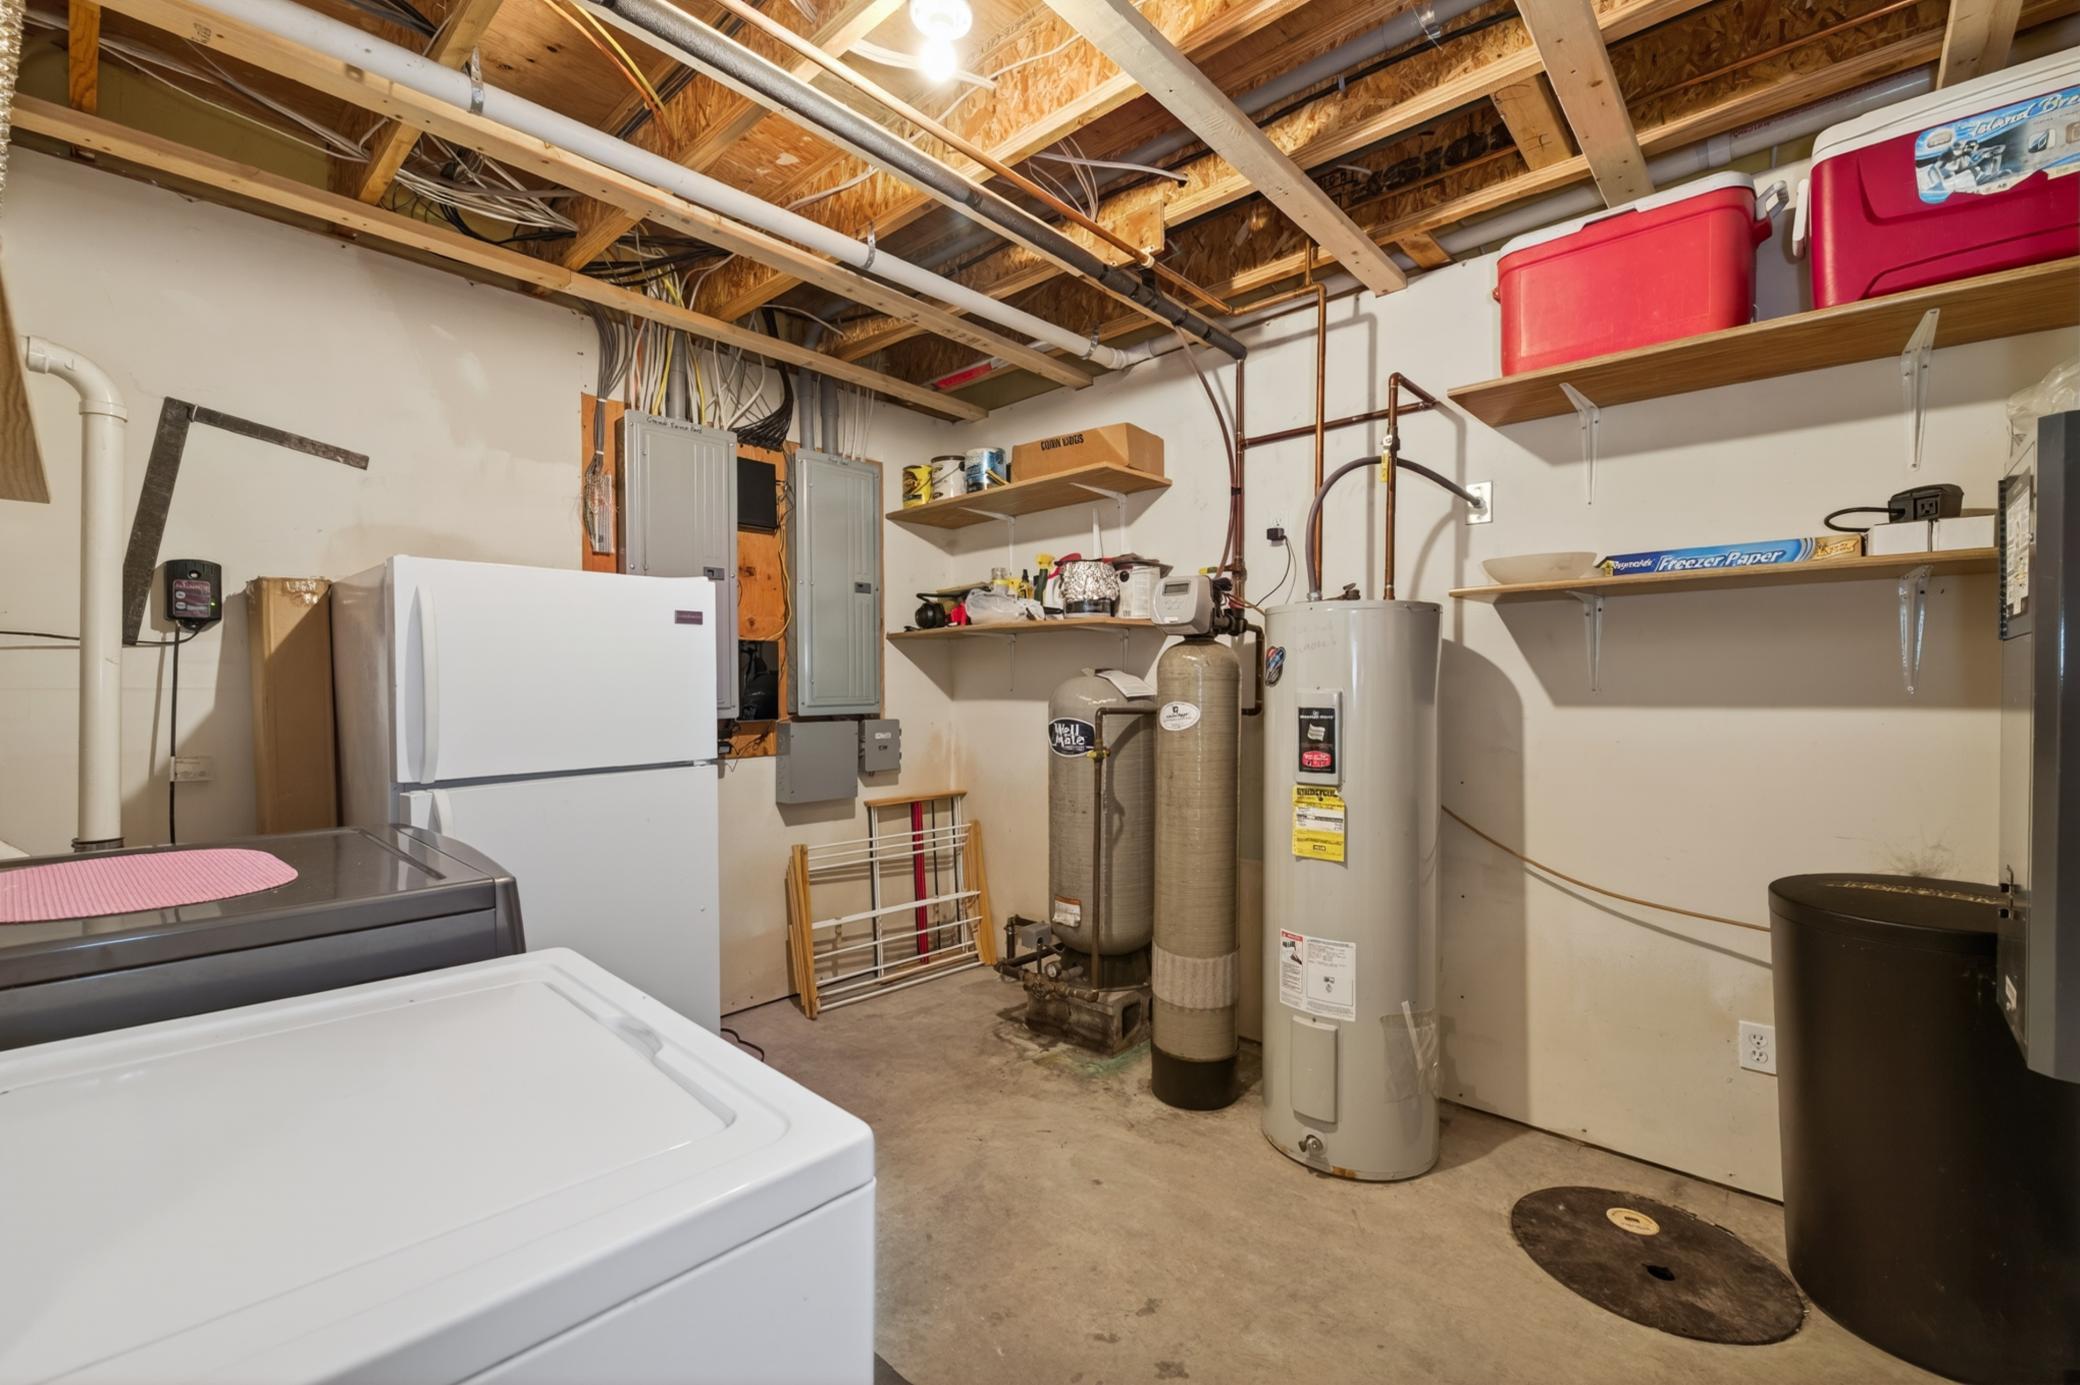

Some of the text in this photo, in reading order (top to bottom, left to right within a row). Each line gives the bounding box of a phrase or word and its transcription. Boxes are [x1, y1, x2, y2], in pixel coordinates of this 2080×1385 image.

[1657, 555, 1724, 571] Freezer
[1725, 549, 1783, 568] Paper
[1054, 722, 1079, 737] Well
[1052, 734, 1085, 747] Mate
